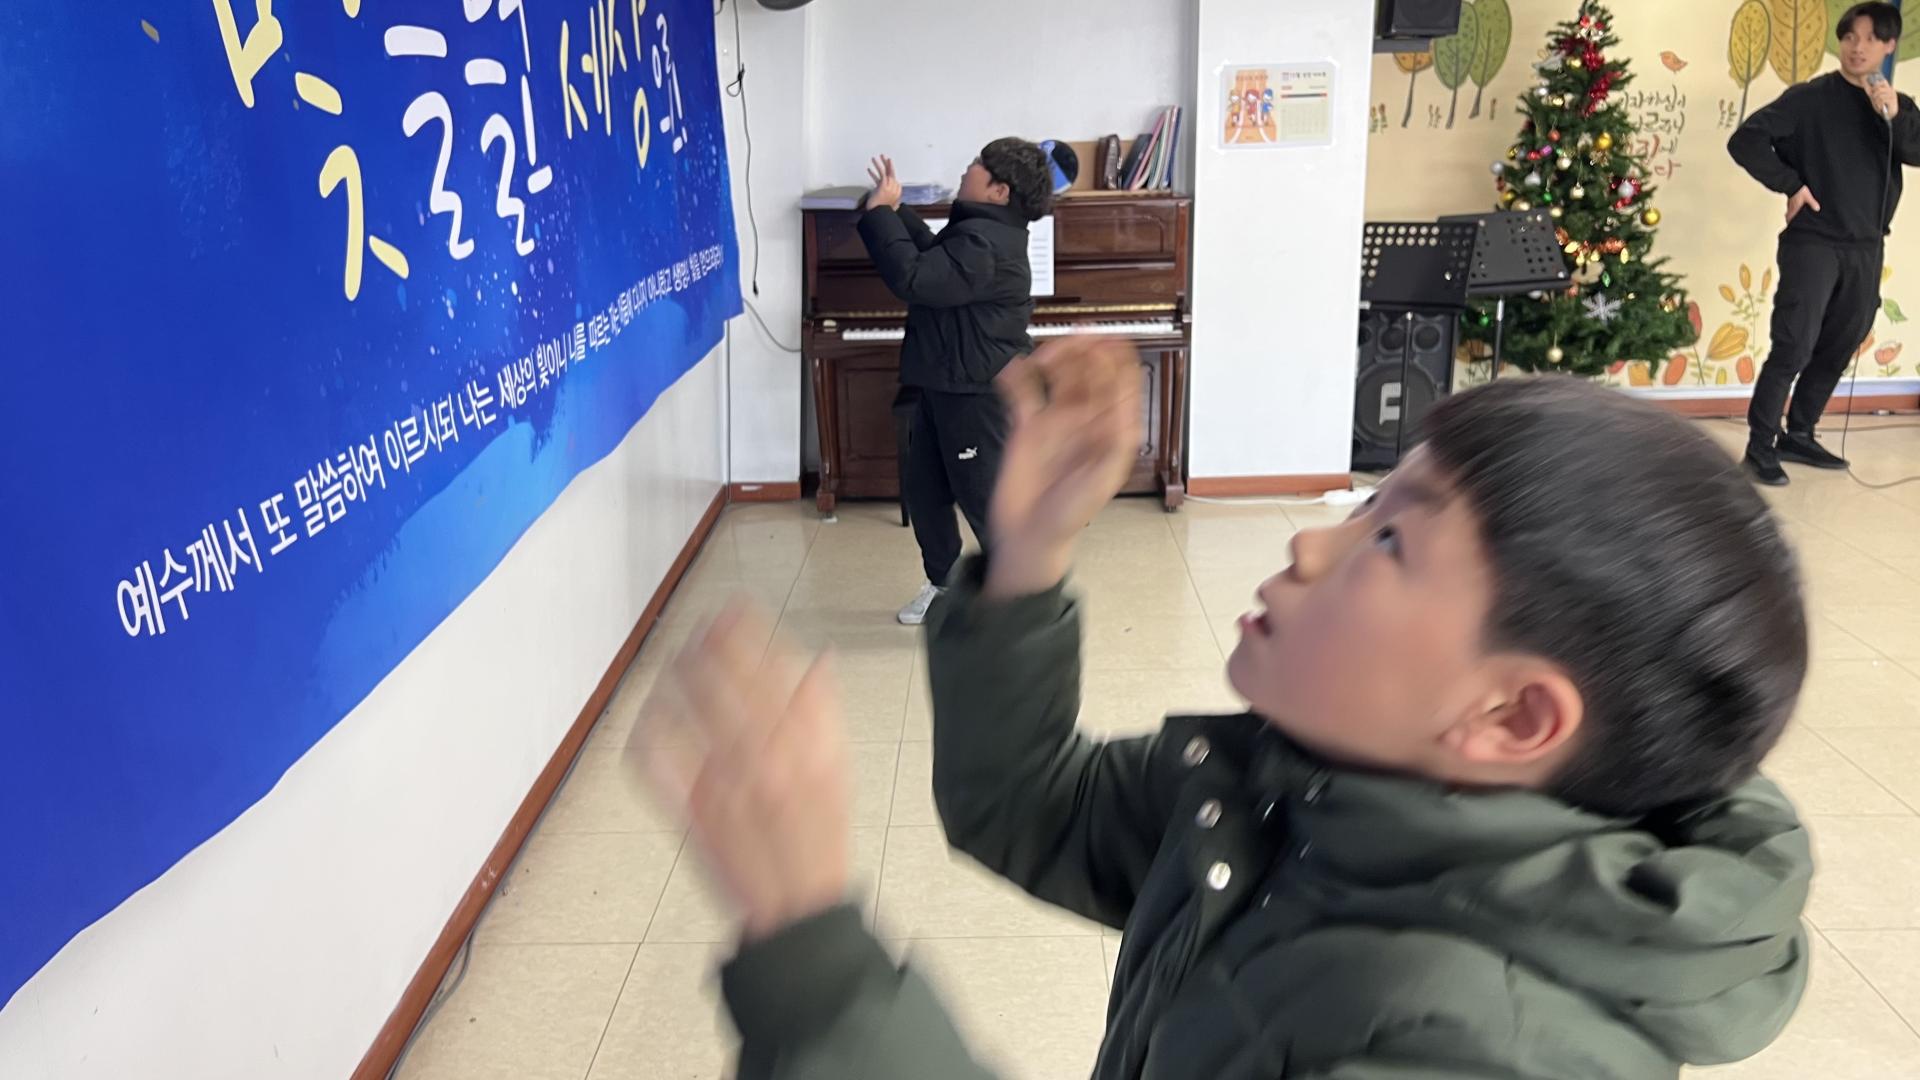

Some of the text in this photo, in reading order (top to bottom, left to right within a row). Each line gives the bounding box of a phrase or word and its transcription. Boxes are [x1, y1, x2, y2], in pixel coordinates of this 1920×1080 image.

[116, 507, 263, 637] 예수께서
[259, 492, 298, 556] 또
[294, 434, 386, 538] 말씀하여
[384, 393, 459, 475] 이르시되
[457, 379, 497, 430] 나는
[497, 348, 537, 409] 세상의
[535, 331, 568, 385] 빛이니
[568, 322, 587, 364] 나를
[589, 310, 611, 352] 따르는
